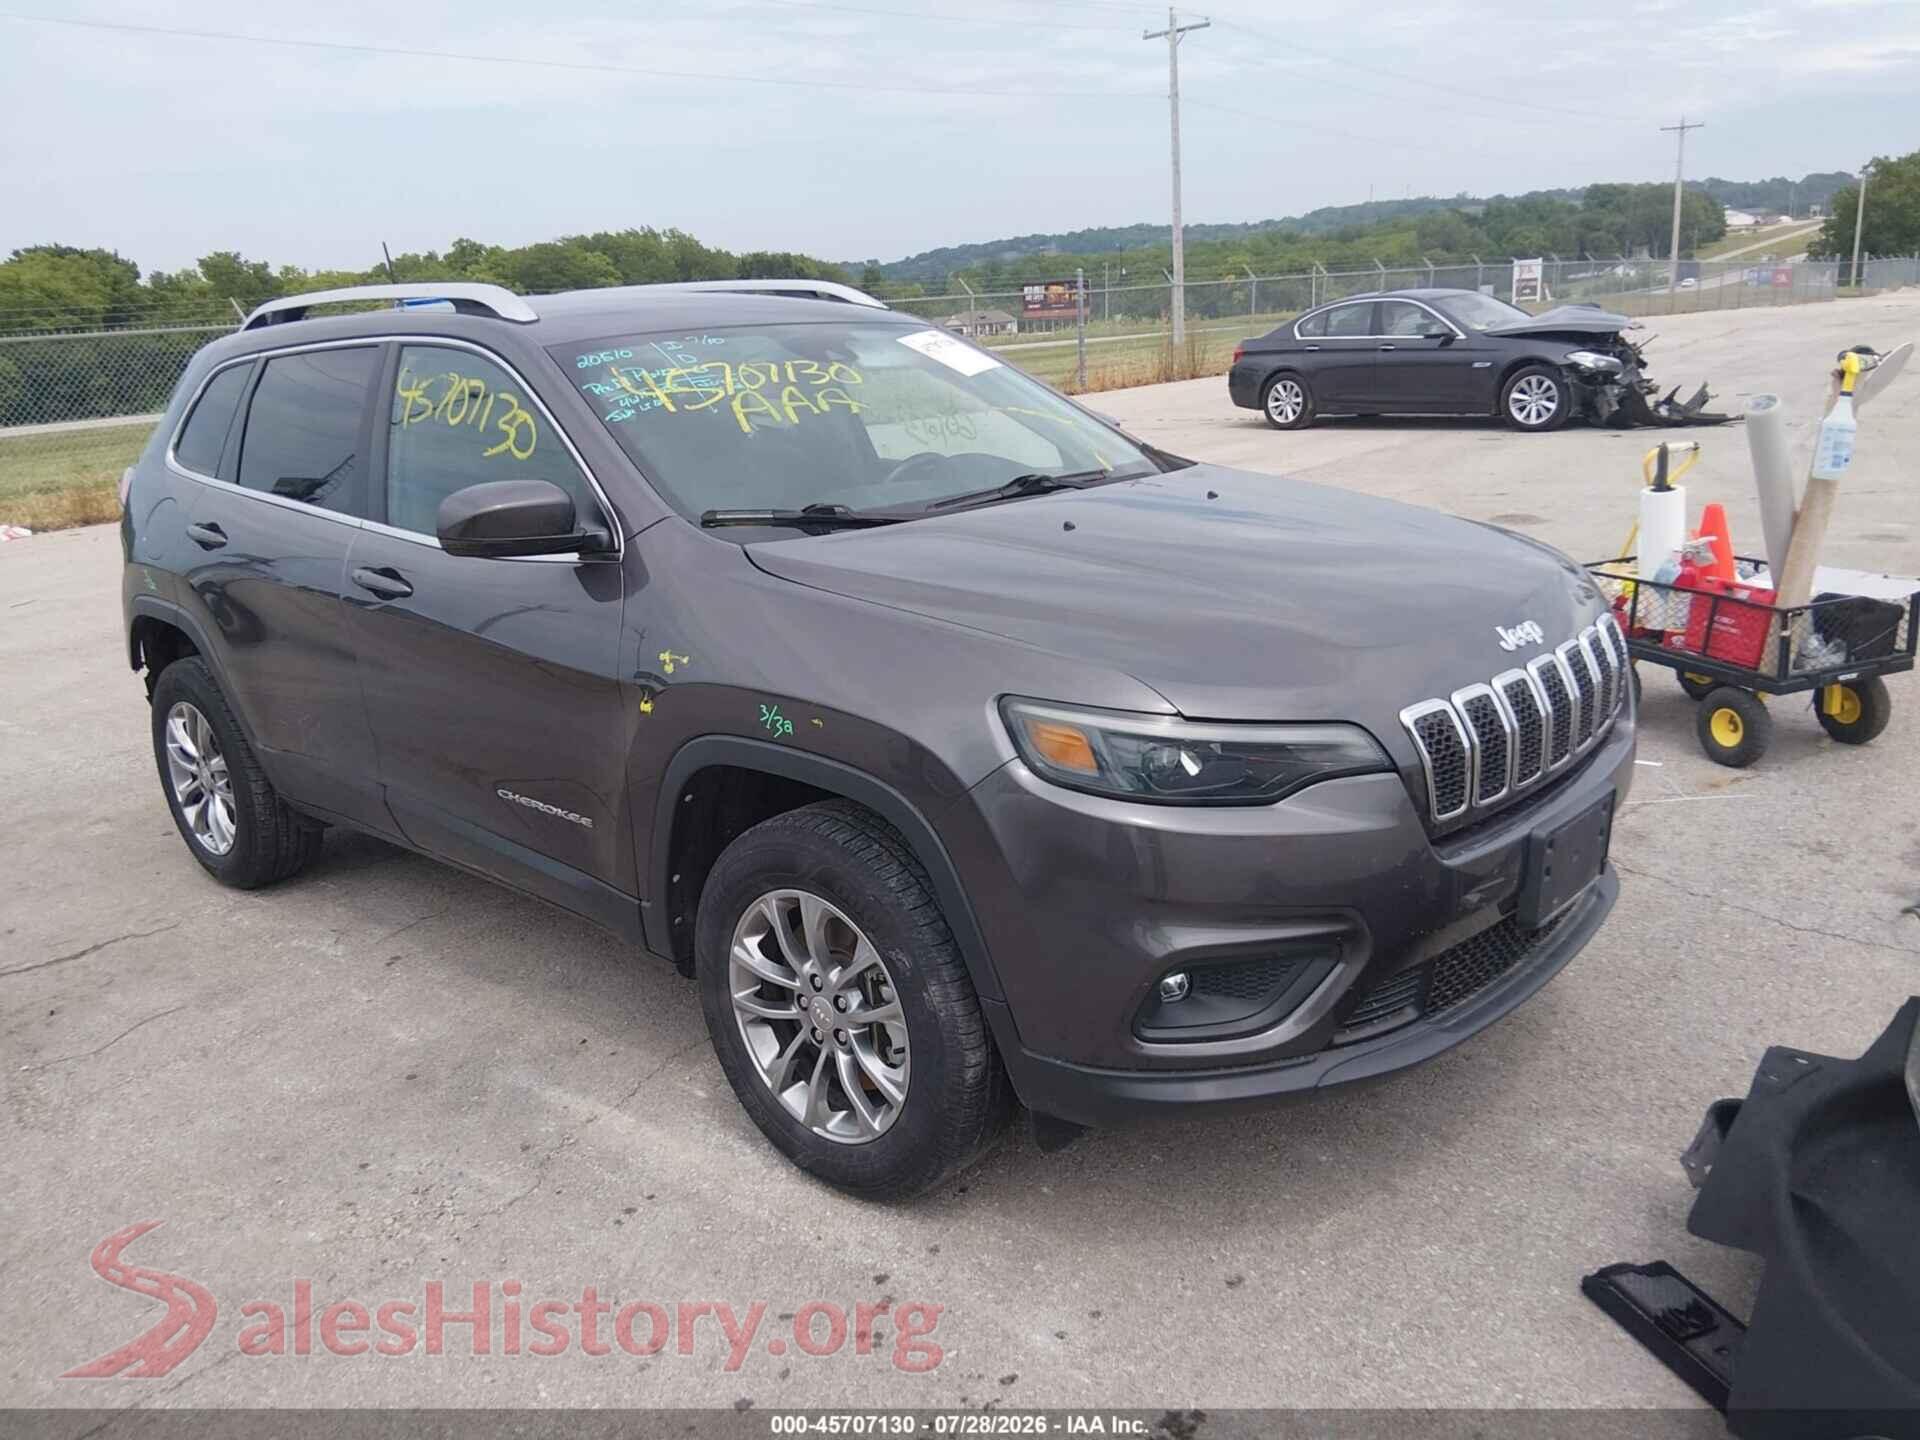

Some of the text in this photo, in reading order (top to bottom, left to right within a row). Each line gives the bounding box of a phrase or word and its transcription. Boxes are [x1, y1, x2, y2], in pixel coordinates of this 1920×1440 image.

[610, 360, 863, 412] 45707130
[732, 386, 871, 433] AAA
[397, 367, 536, 460] 45707130
[1495, 620, 1544, 651] Jeep
[497, 789, 593, 828] CHEROKEE
